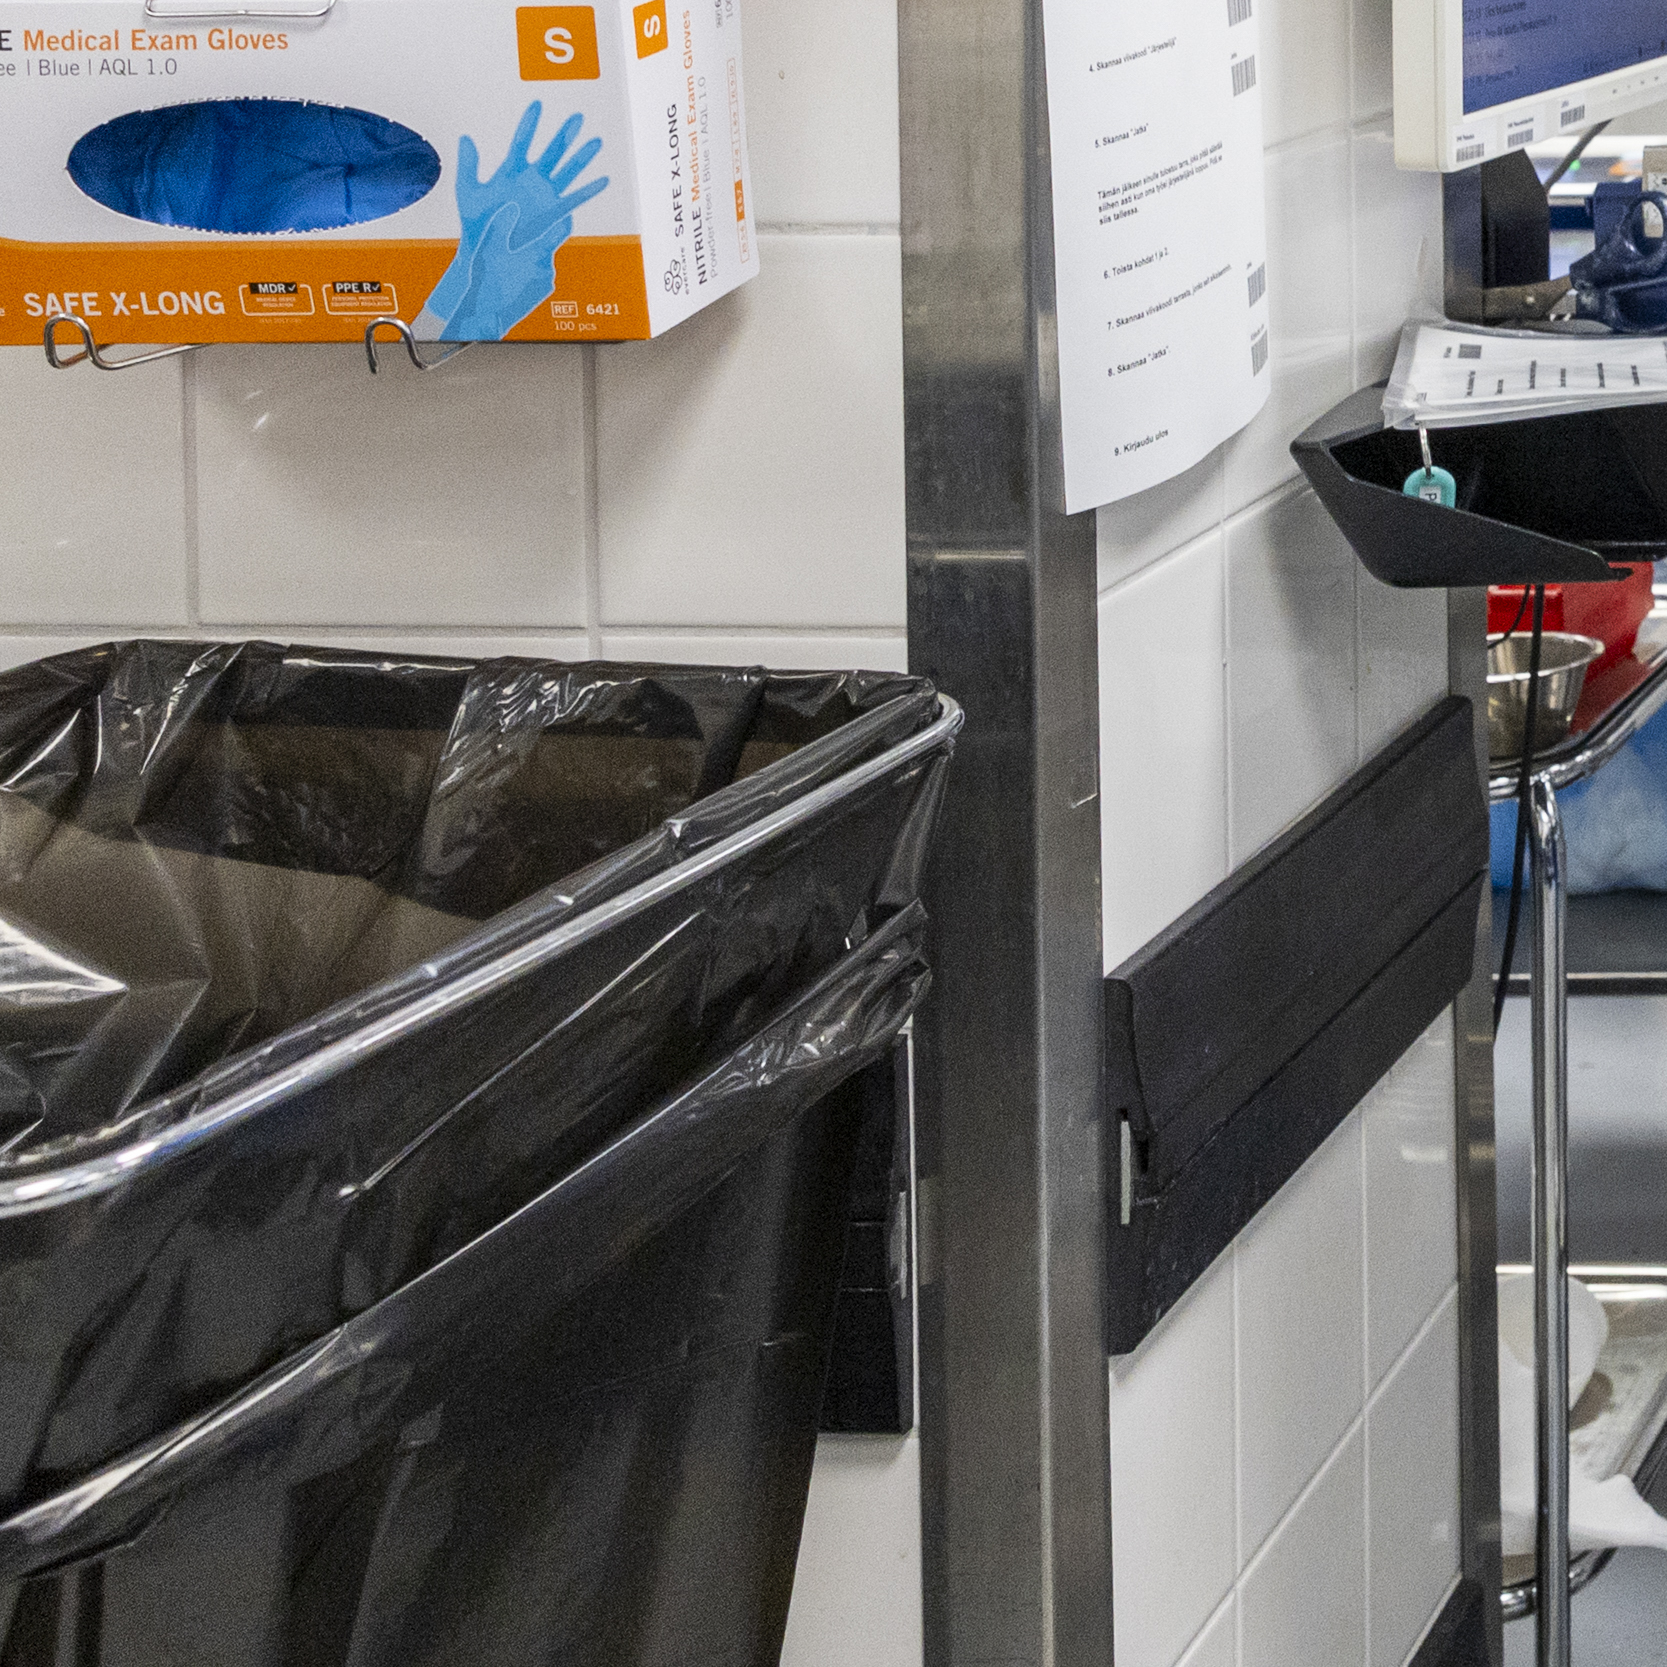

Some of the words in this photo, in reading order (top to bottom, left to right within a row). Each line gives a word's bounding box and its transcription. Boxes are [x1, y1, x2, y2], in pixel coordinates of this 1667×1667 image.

[643, 14, 661, 39] S
[23, 29, 119, 51] Medical
[131, 29, 198, 50] Exam
[208, 28, 289, 50] Gloves
[543, 26, 575, 64] S
[683, 10, 693, 69] Gloves
[38, 59, 80, 76] Blue
[100, 59, 138, 76] AQL
[147, 58, 178, 76] 1.0
[686, 75, 697, 125] Exam
[667, 103, 681, 181] X-LONG
[688, 130, 702, 202] Medical
[673, 186, 685, 237] SAFE
[692, 207, 708, 285] NITRILE
[258, 283, 287, 294] MDR
[335, 282, 361, 293] PPE
[23, 291, 102, 317] SAFE
[110, 291, 226, 316] X-LONG
[555, 305, 576, 315] REF
[586, 304, 620, 315] 6421
[554, 320, 575, 331] 100
[579, 321, 597, 332] pcs
[1115, 311, 1144, 327] Skannaa
[1117, 357, 1147, 374] Skannaa
[1123, 435, 1154, 453] Kirjaudu
